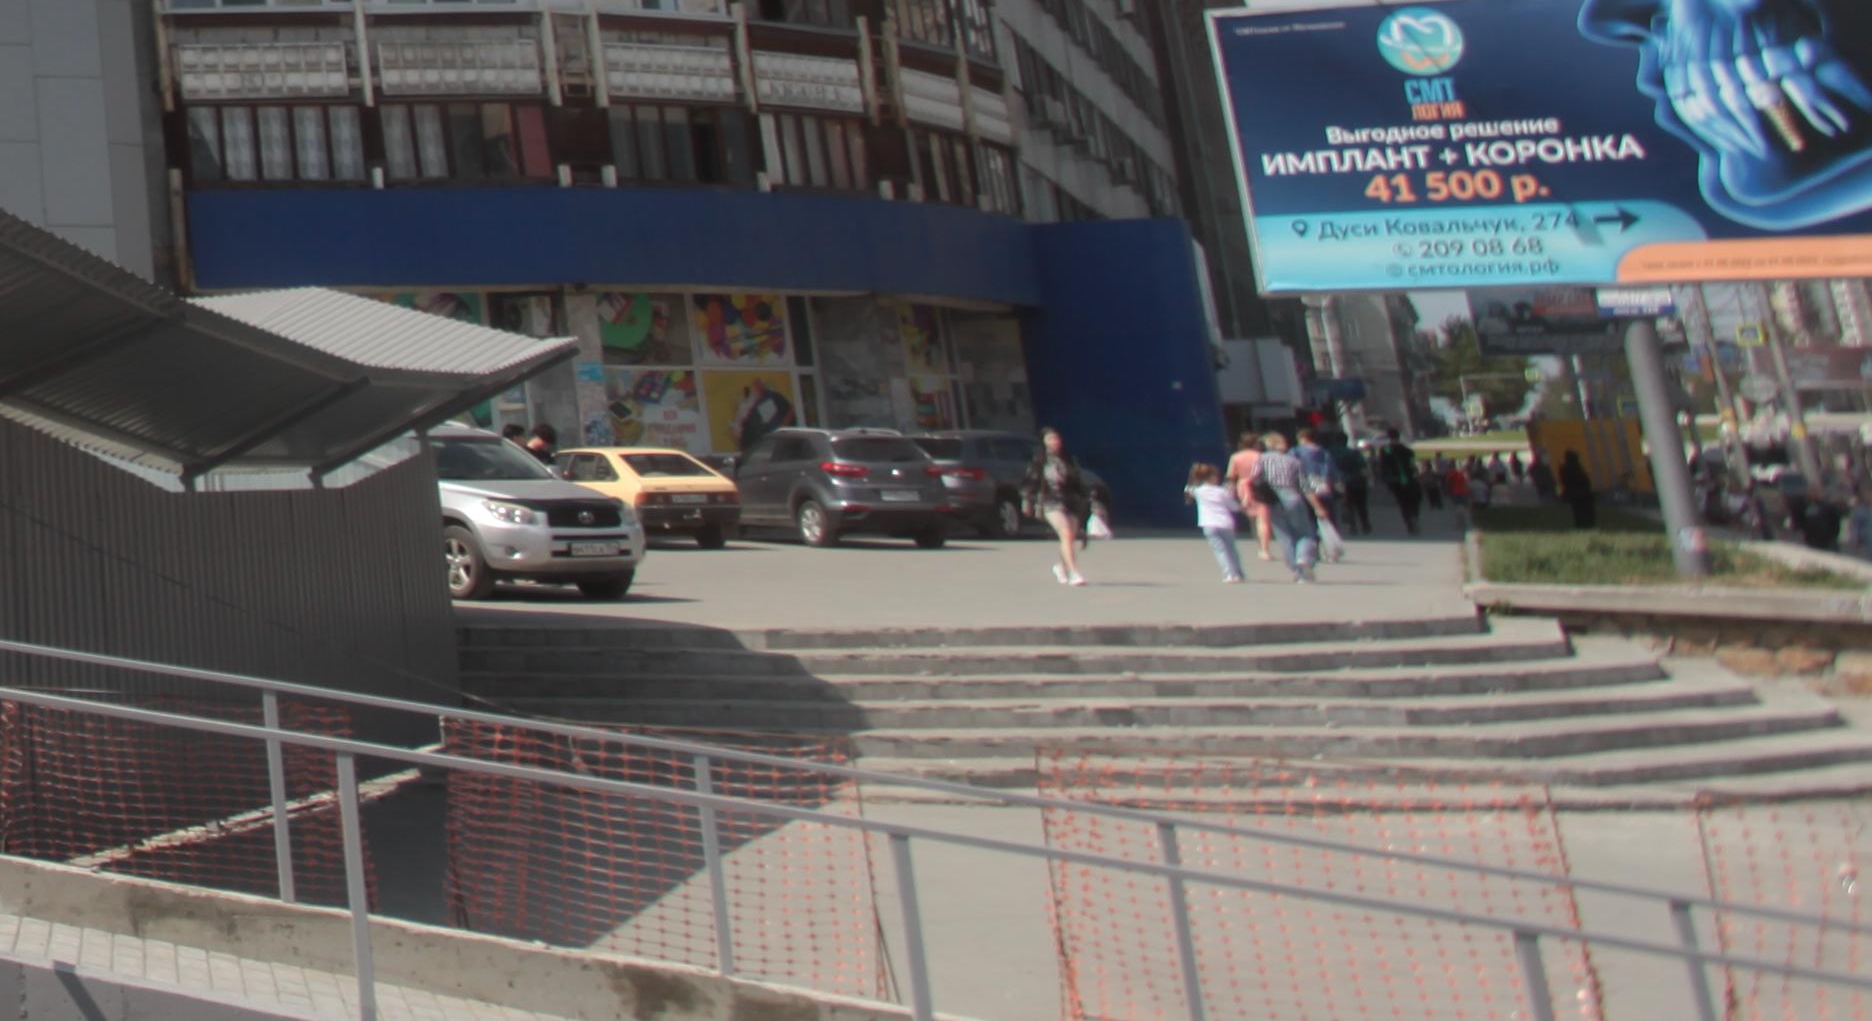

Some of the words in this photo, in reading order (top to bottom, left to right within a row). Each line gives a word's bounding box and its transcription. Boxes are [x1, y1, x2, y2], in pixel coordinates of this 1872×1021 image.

[1404, 77, 1456, 104] СМТ
[1325, 124, 1444, 146] Выгодное
[1449, 117, 1559, 140] решение
[1261, 145, 1431, 176] ИМПЛАНТ
[1465, 133, 1645, 167] КОРОНКА
[1364, 173, 1416, 203] 41
[1425, 169, 1503, 200] 500
[1511, 174, 1550, 203] р.
[1317, 220, 1378, 241] Дуси
[1385, 214, 1525, 237] Ковальчук,
[1531, 211, 1581, 231] 274
[1418, 241, 1464, 259] 209
[1471, 239, 1504, 257] 08
[1512, 238, 1544, 256] 68
